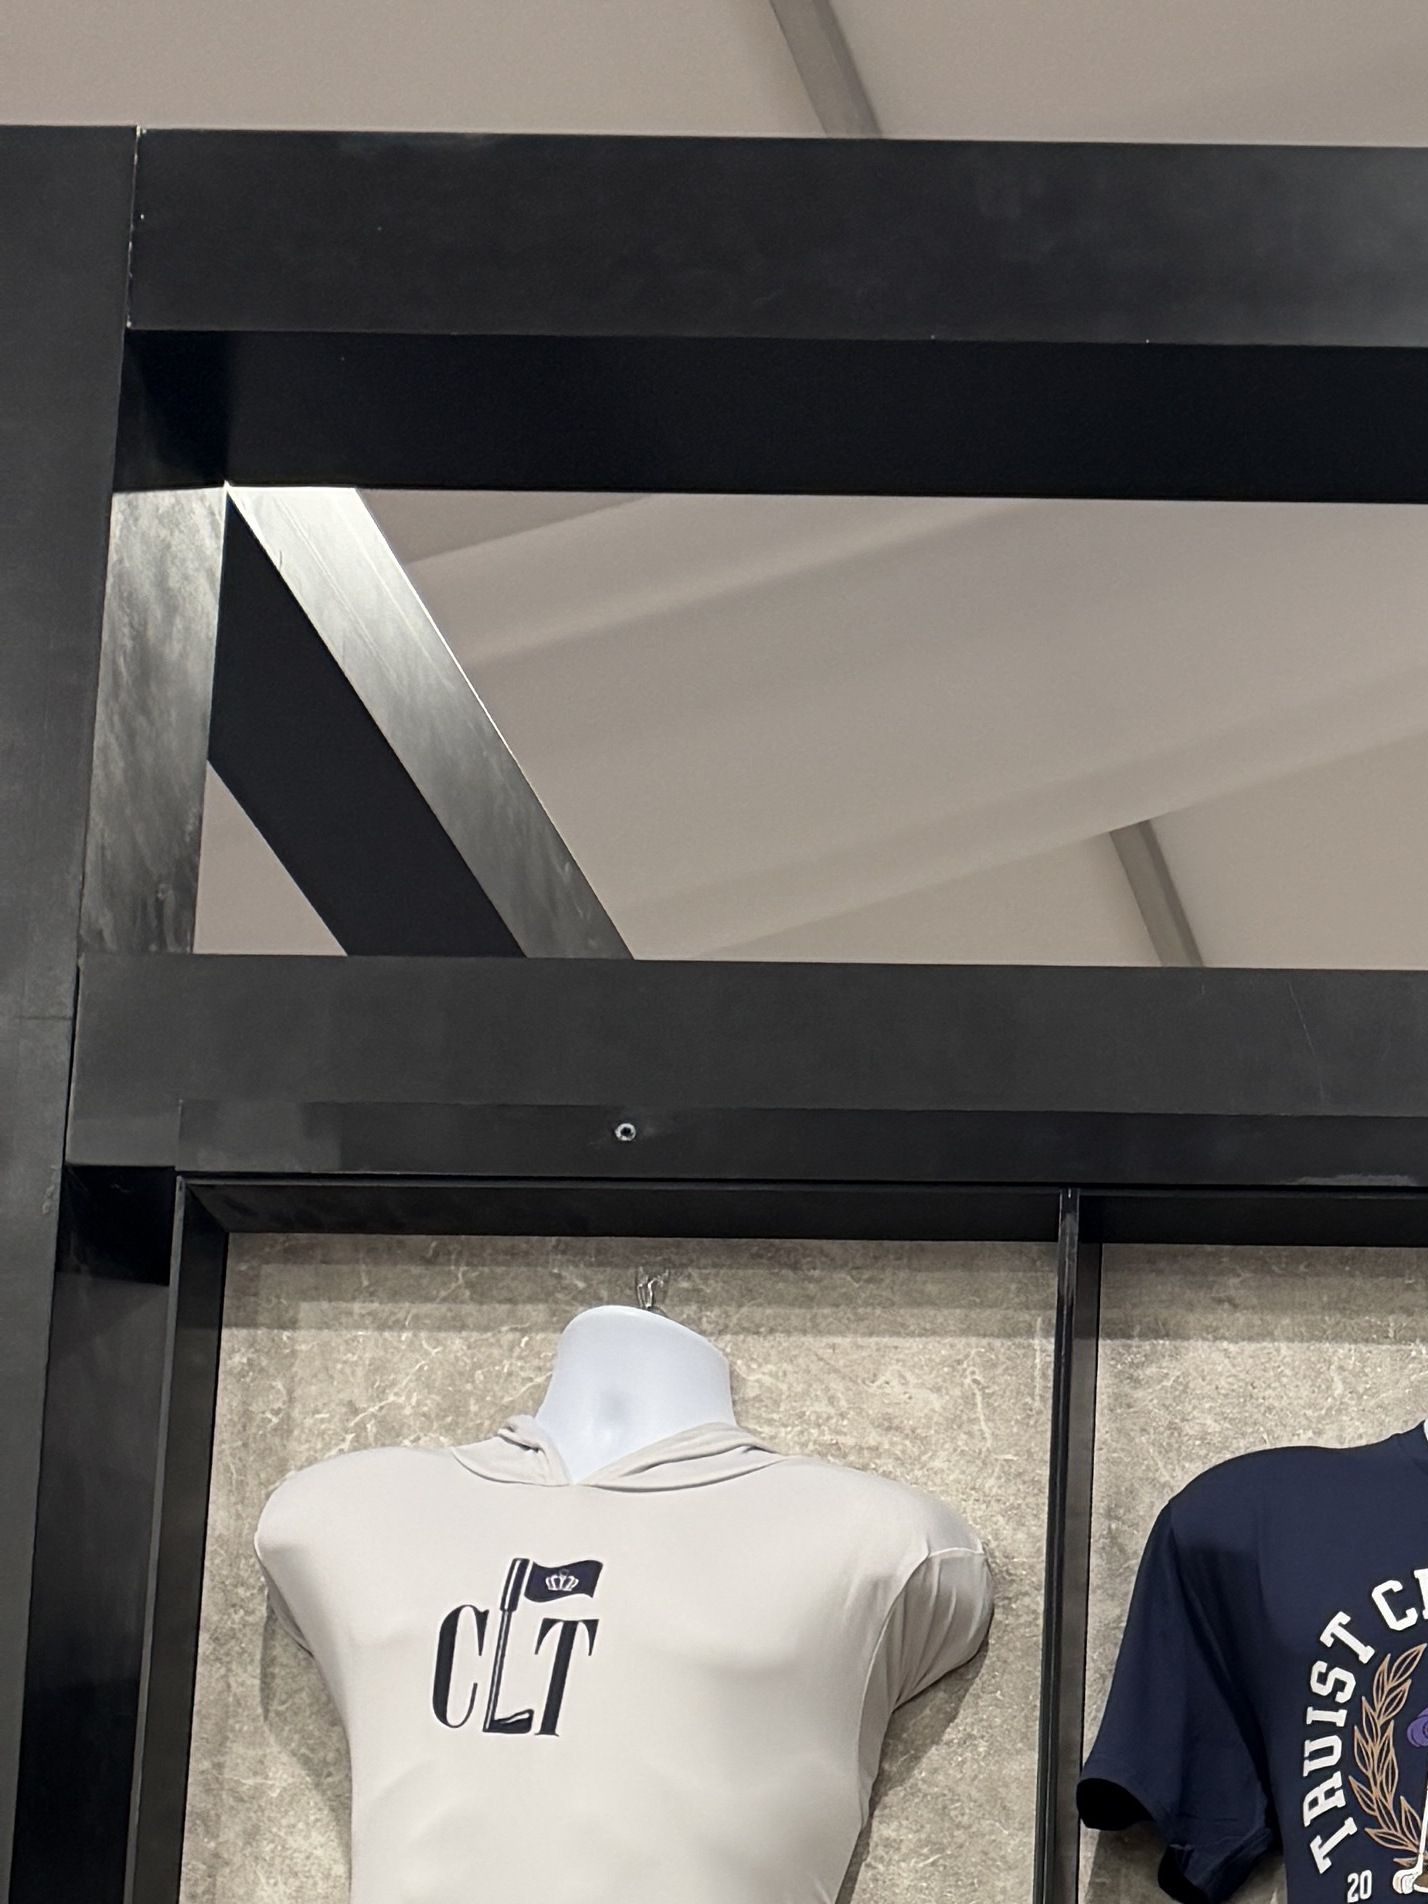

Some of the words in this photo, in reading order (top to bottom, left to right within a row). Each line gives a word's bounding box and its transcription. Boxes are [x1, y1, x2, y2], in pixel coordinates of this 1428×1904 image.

[430, 1558, 600, 1739] CLT
[1302, 1610, 1376, 1875] TRUIST
[1346, 1869, 1373, 1903] 20
